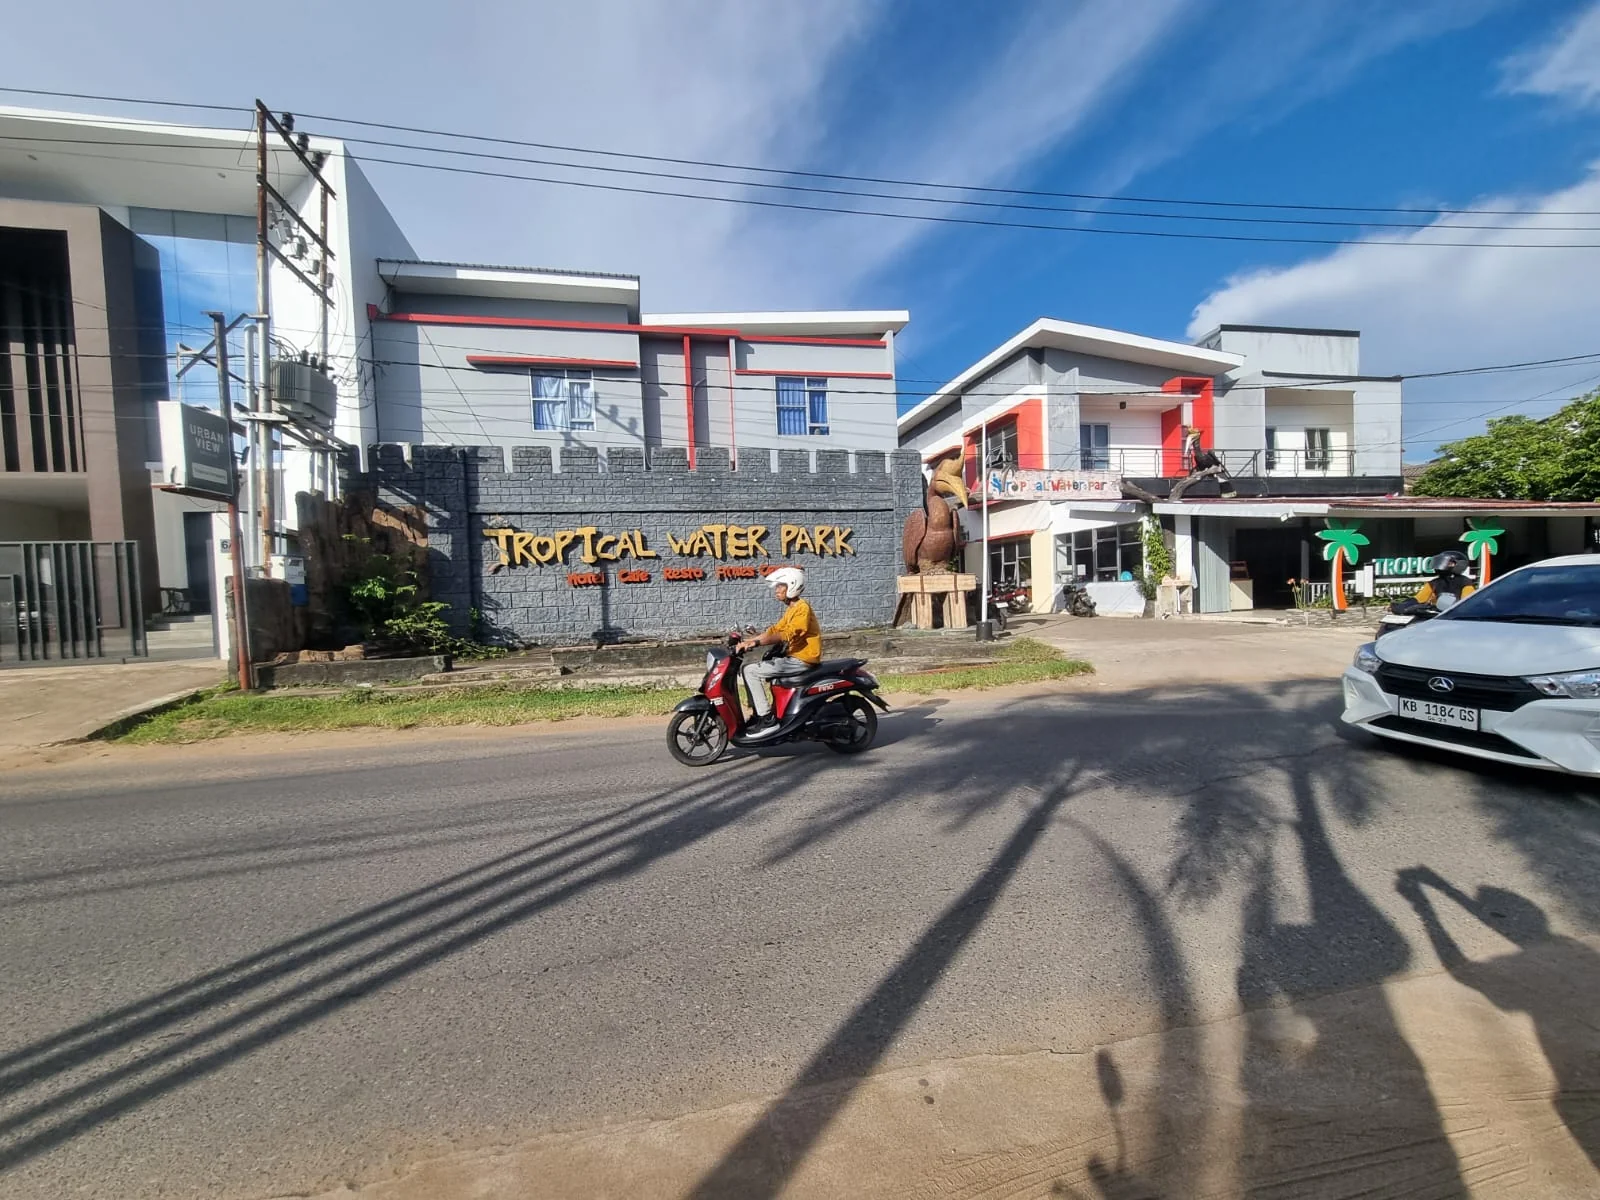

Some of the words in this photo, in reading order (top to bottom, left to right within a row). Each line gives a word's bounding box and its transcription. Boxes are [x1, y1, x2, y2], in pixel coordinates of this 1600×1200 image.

[189, 423, 224, 444] URBAN
[195, 437, 220, 454] VIEW
[482, 526, 657, 566] TROPICAL
[666, 524, 769, 559] WATER
[781, 524, 854, 556] PARK
[1372, 556, 1436, 576] TROPIC
[1402, 700, 1418, 712] KB
[1424, 703, 1456, 718] 1184
[1459, 709, 1475, 722] GS
